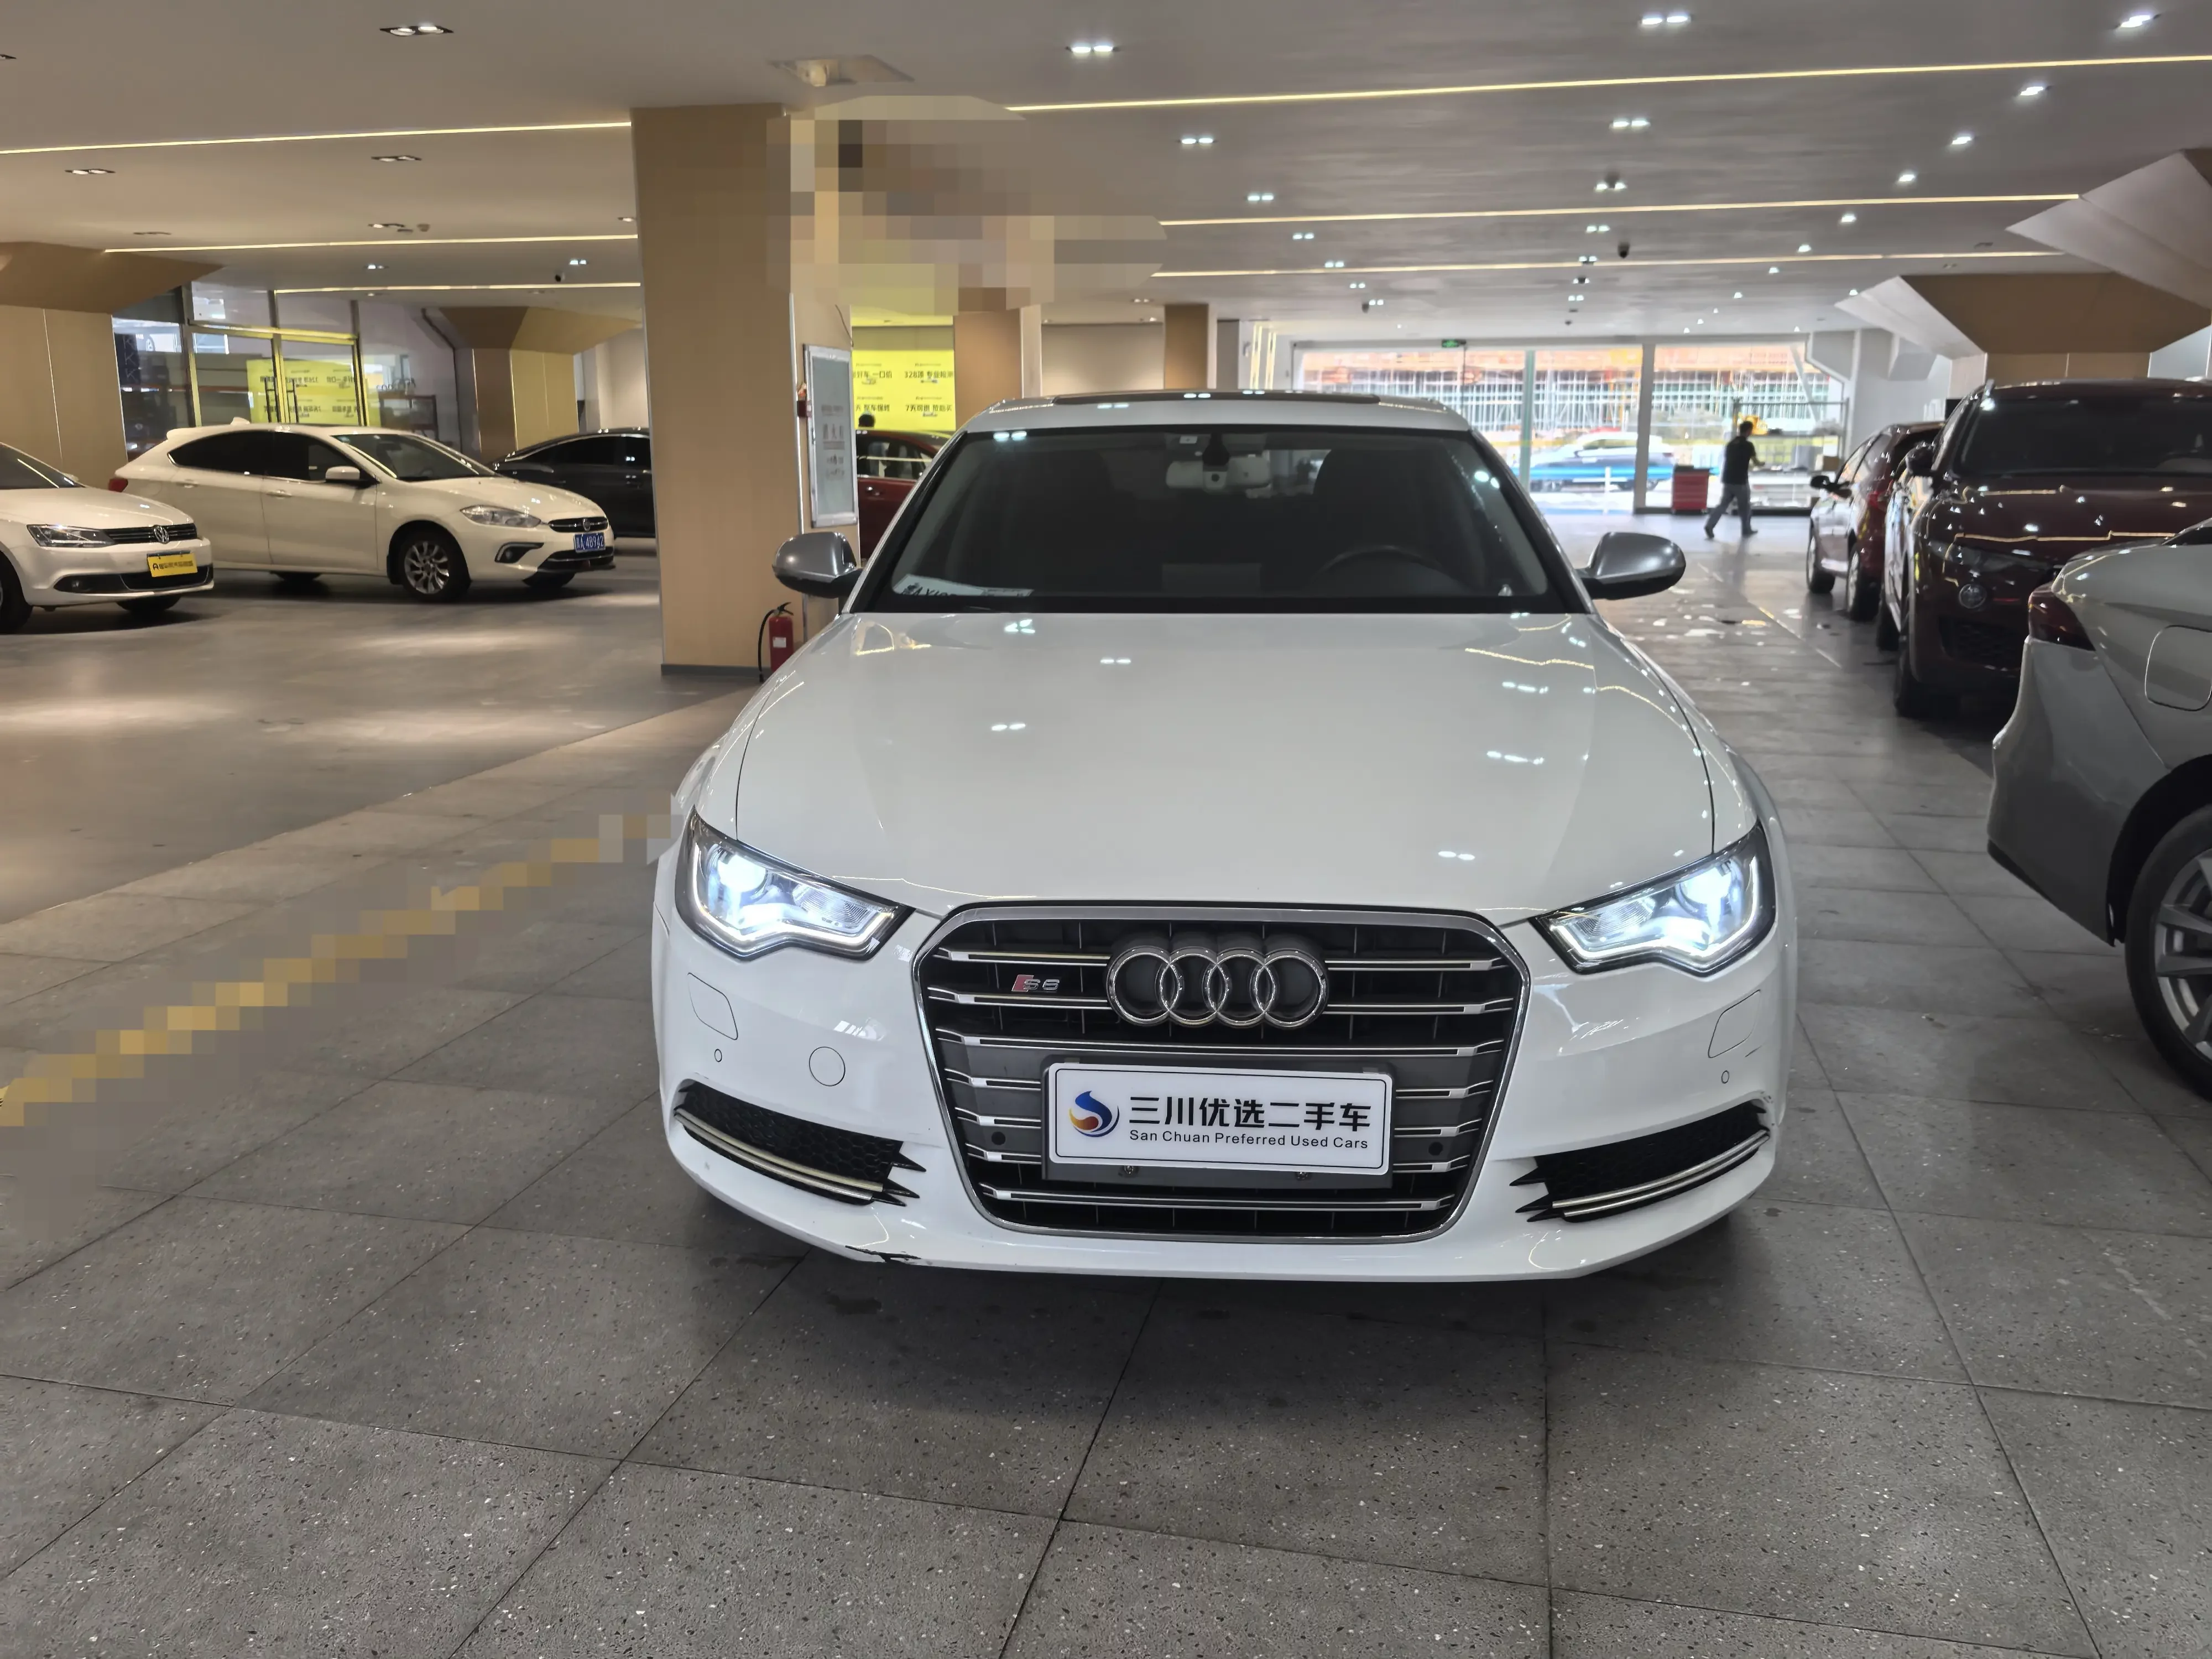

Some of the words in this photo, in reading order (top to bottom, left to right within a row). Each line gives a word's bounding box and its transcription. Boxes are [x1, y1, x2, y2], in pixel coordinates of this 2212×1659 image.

[1129, 1096, 1371, 1132] 三川优选二手车
[1129, 1129, 1157, 1141] San
[1162, 1130, 1209, 1143] Chuan
[1215, 1132, 1286, 1146] Preferred
[1291, 1135, 1328, 1147] Used
[1333, 1136, 1368, 1149] Cars
